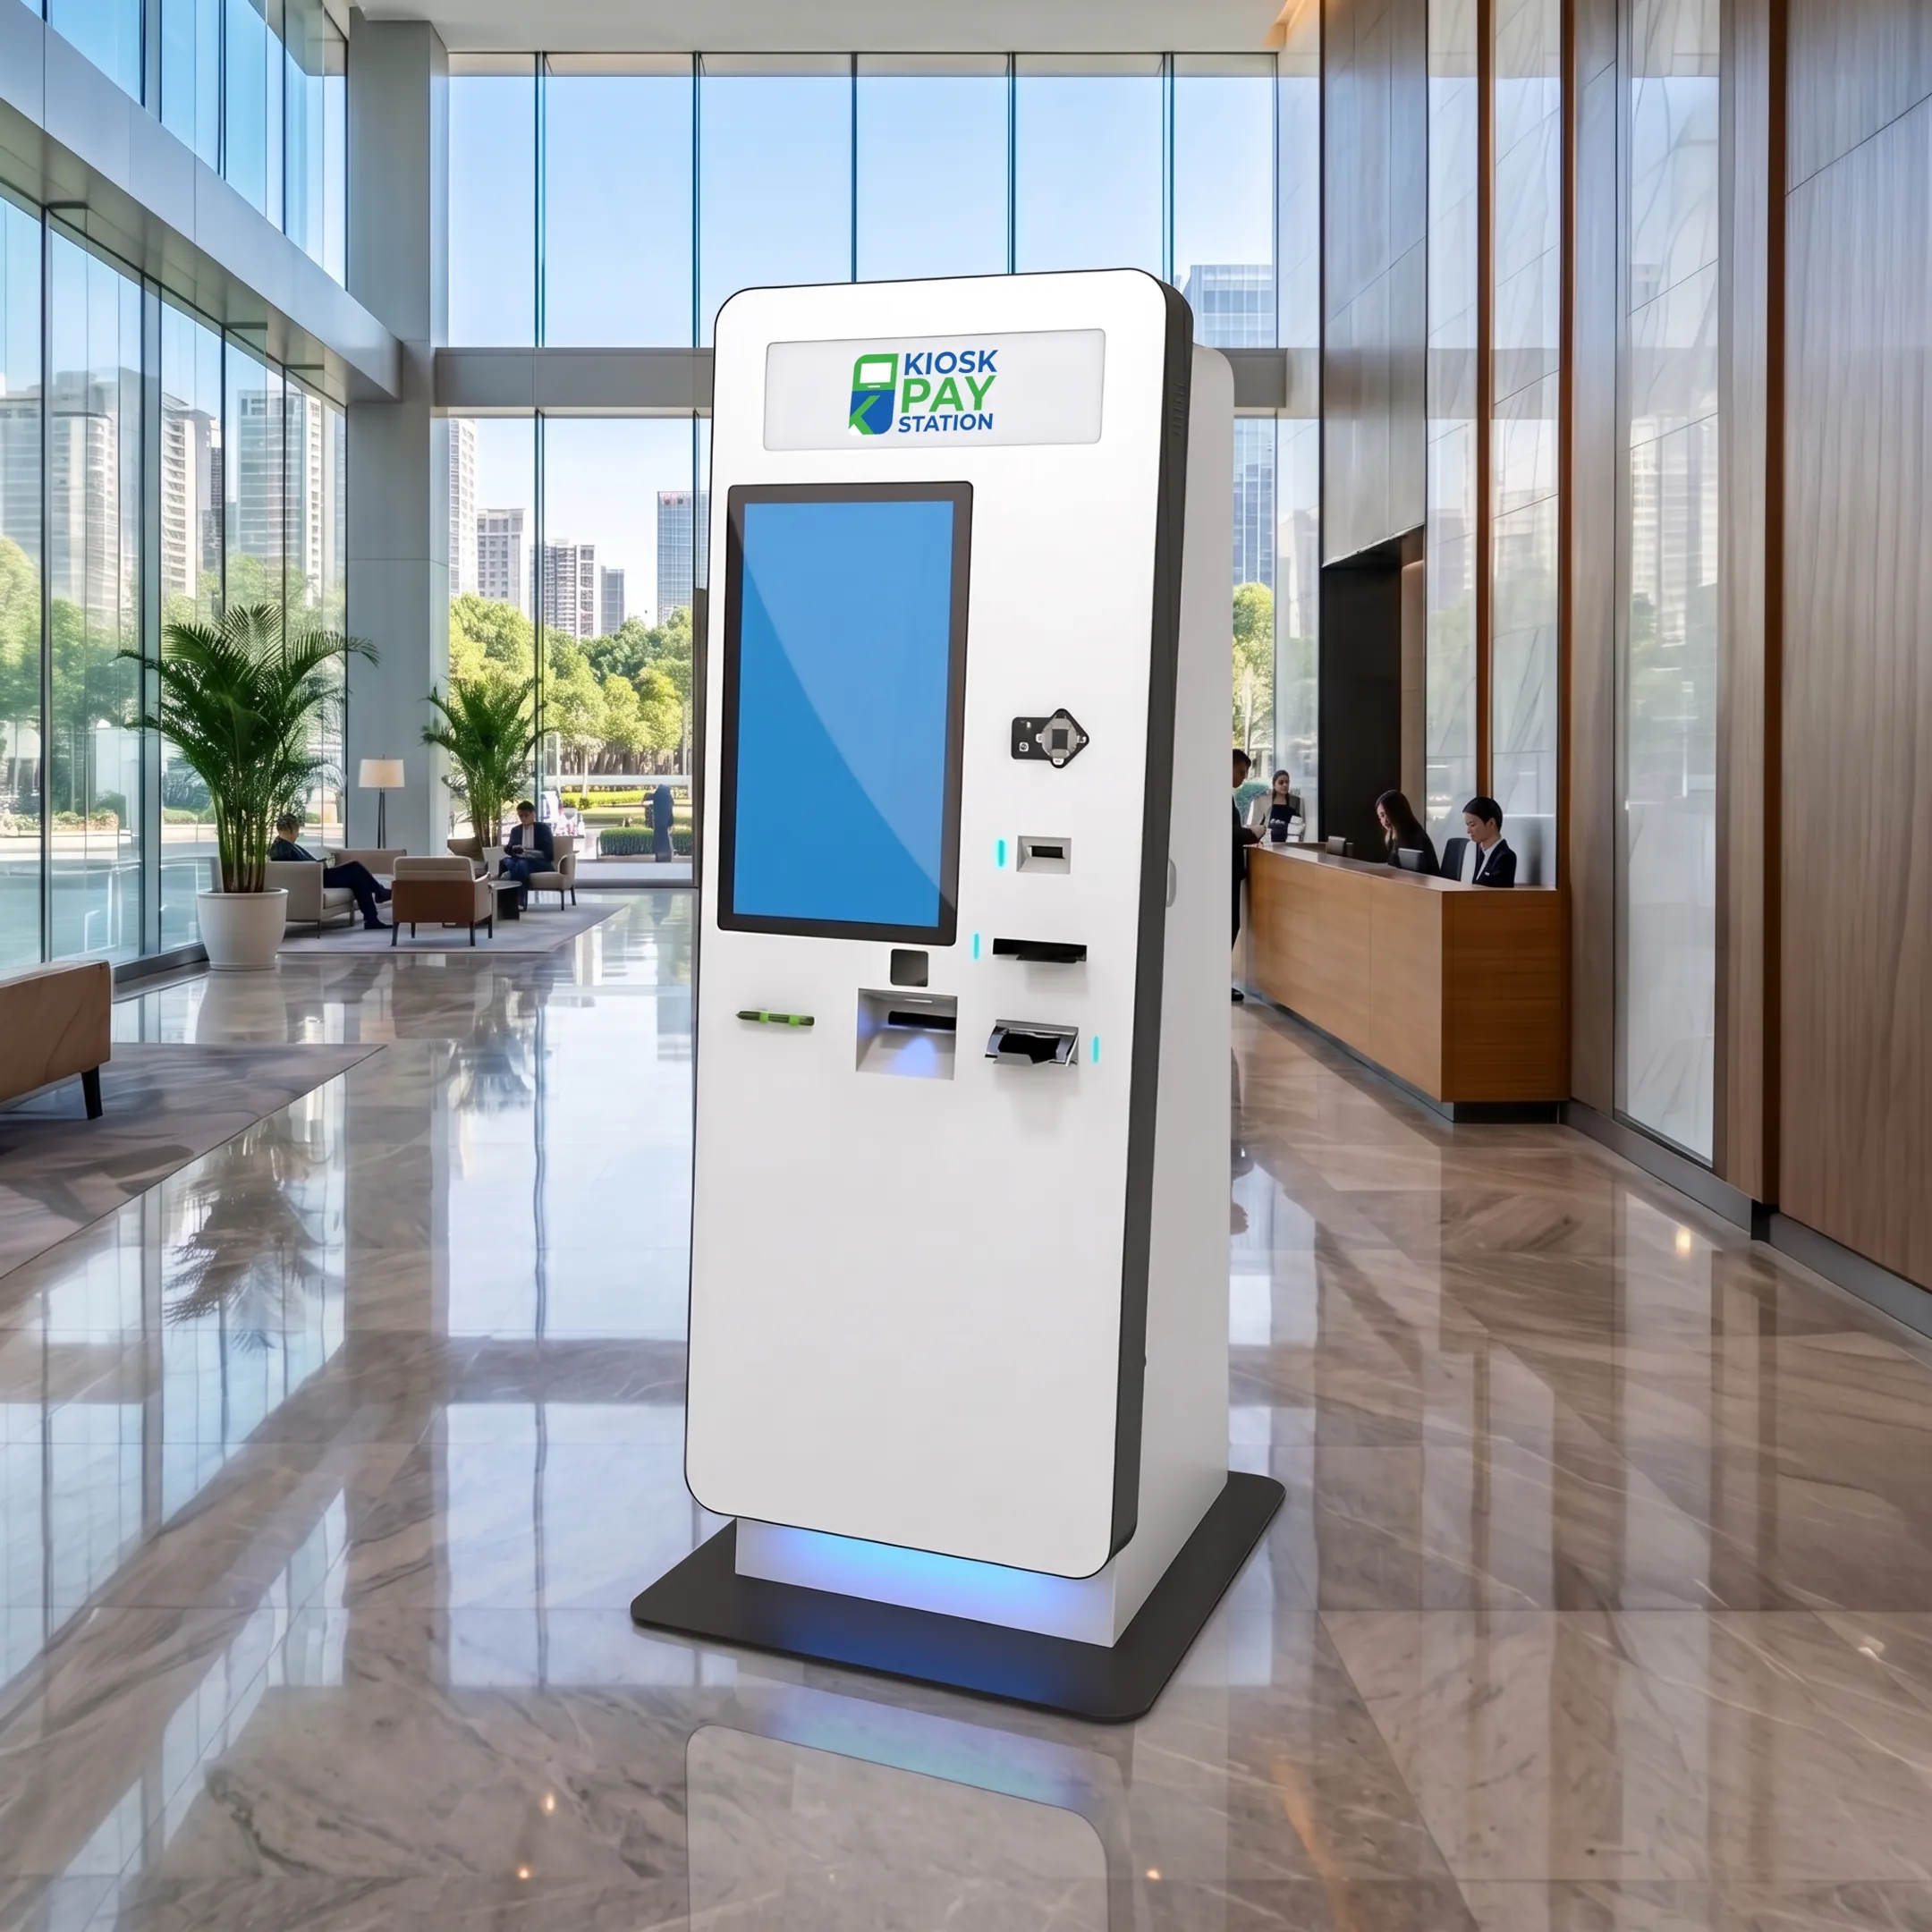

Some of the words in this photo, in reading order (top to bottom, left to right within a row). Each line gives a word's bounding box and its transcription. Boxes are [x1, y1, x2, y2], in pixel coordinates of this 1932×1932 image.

[903, 350, 998, 376] KIOSK
[901, 375, 996, 413] PAY
[898, 413, 994, 433] STATION
